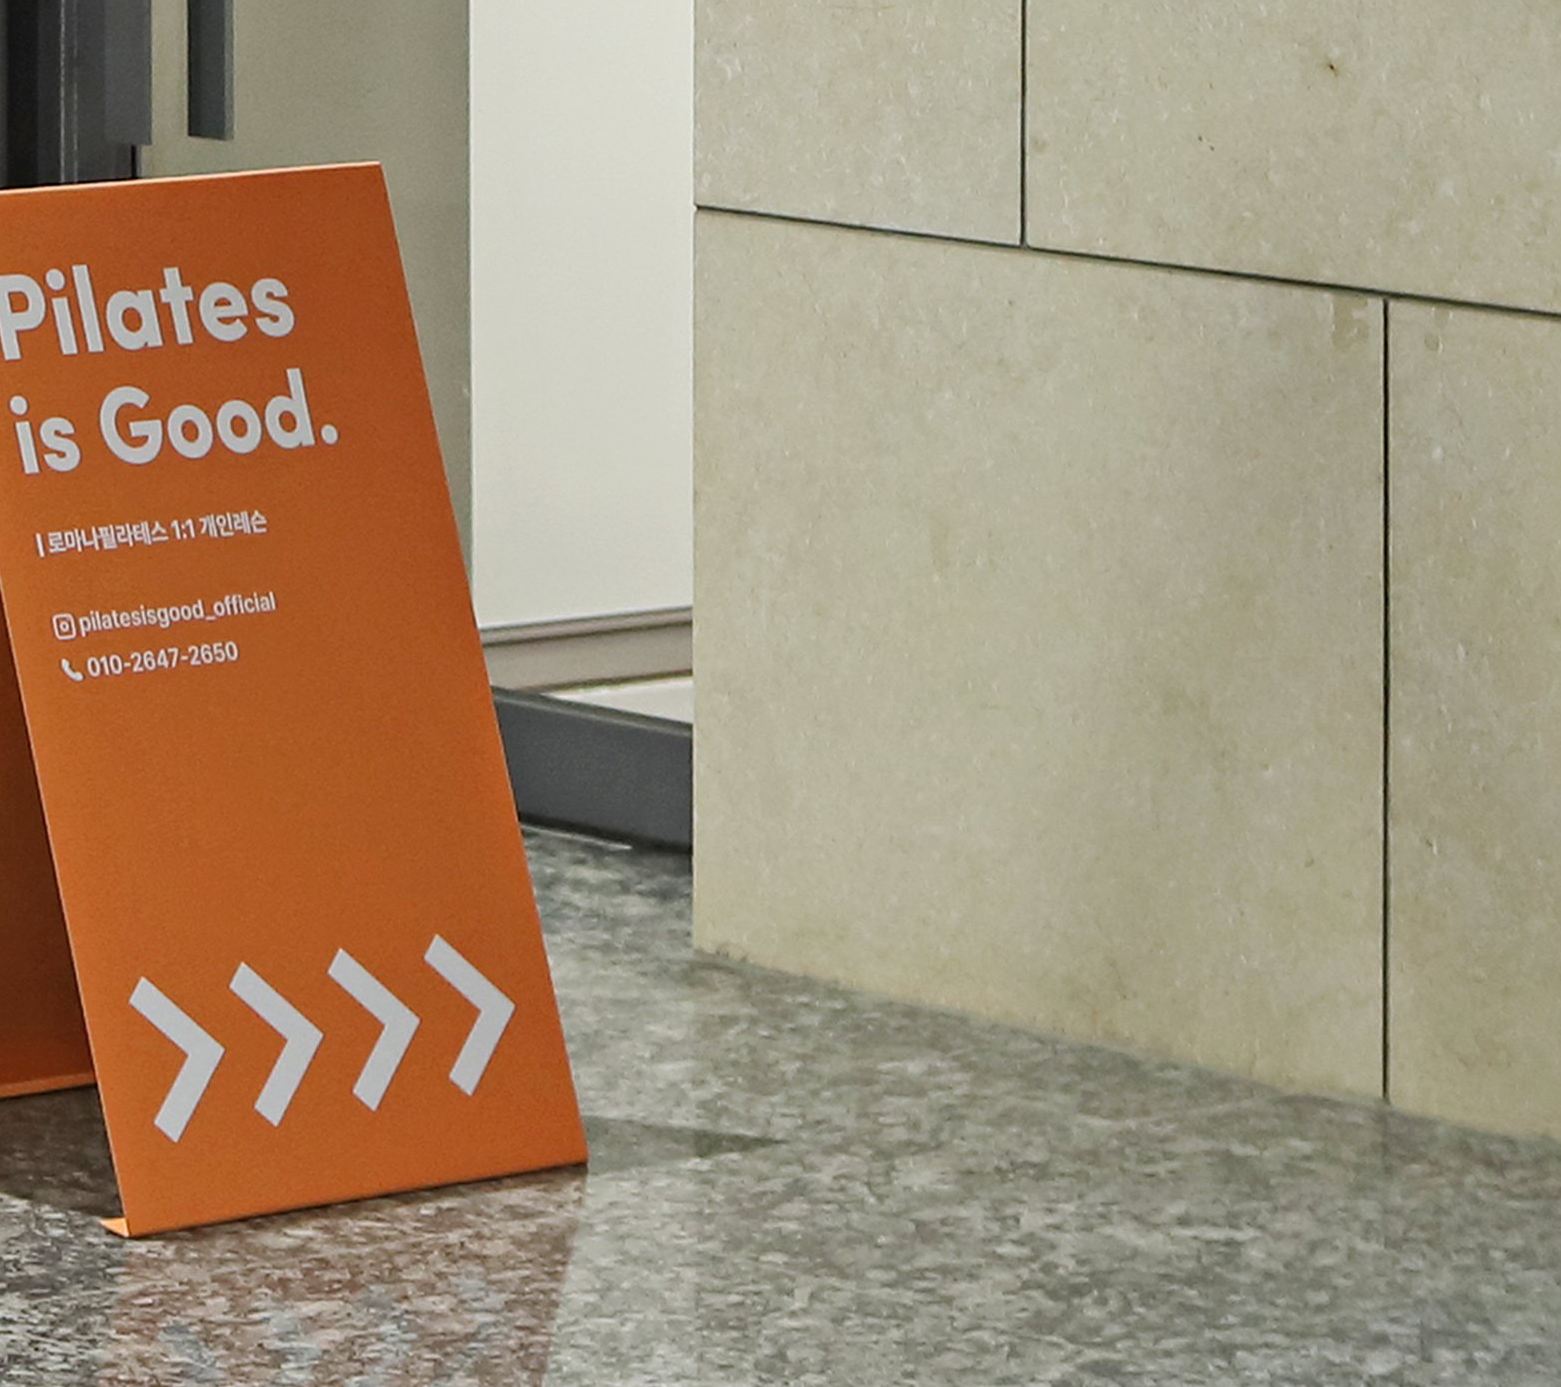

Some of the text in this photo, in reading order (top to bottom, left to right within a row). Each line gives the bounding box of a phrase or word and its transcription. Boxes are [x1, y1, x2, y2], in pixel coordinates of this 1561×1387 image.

[8, 366, 339, 475] is Good.
[47, 510, 268, 554] 로마나필라테스 1:1 개인레슨
[78, 590, 277, 638] pilatesisgood_official
[86, 640, 239, 678] 010-2647-2650
